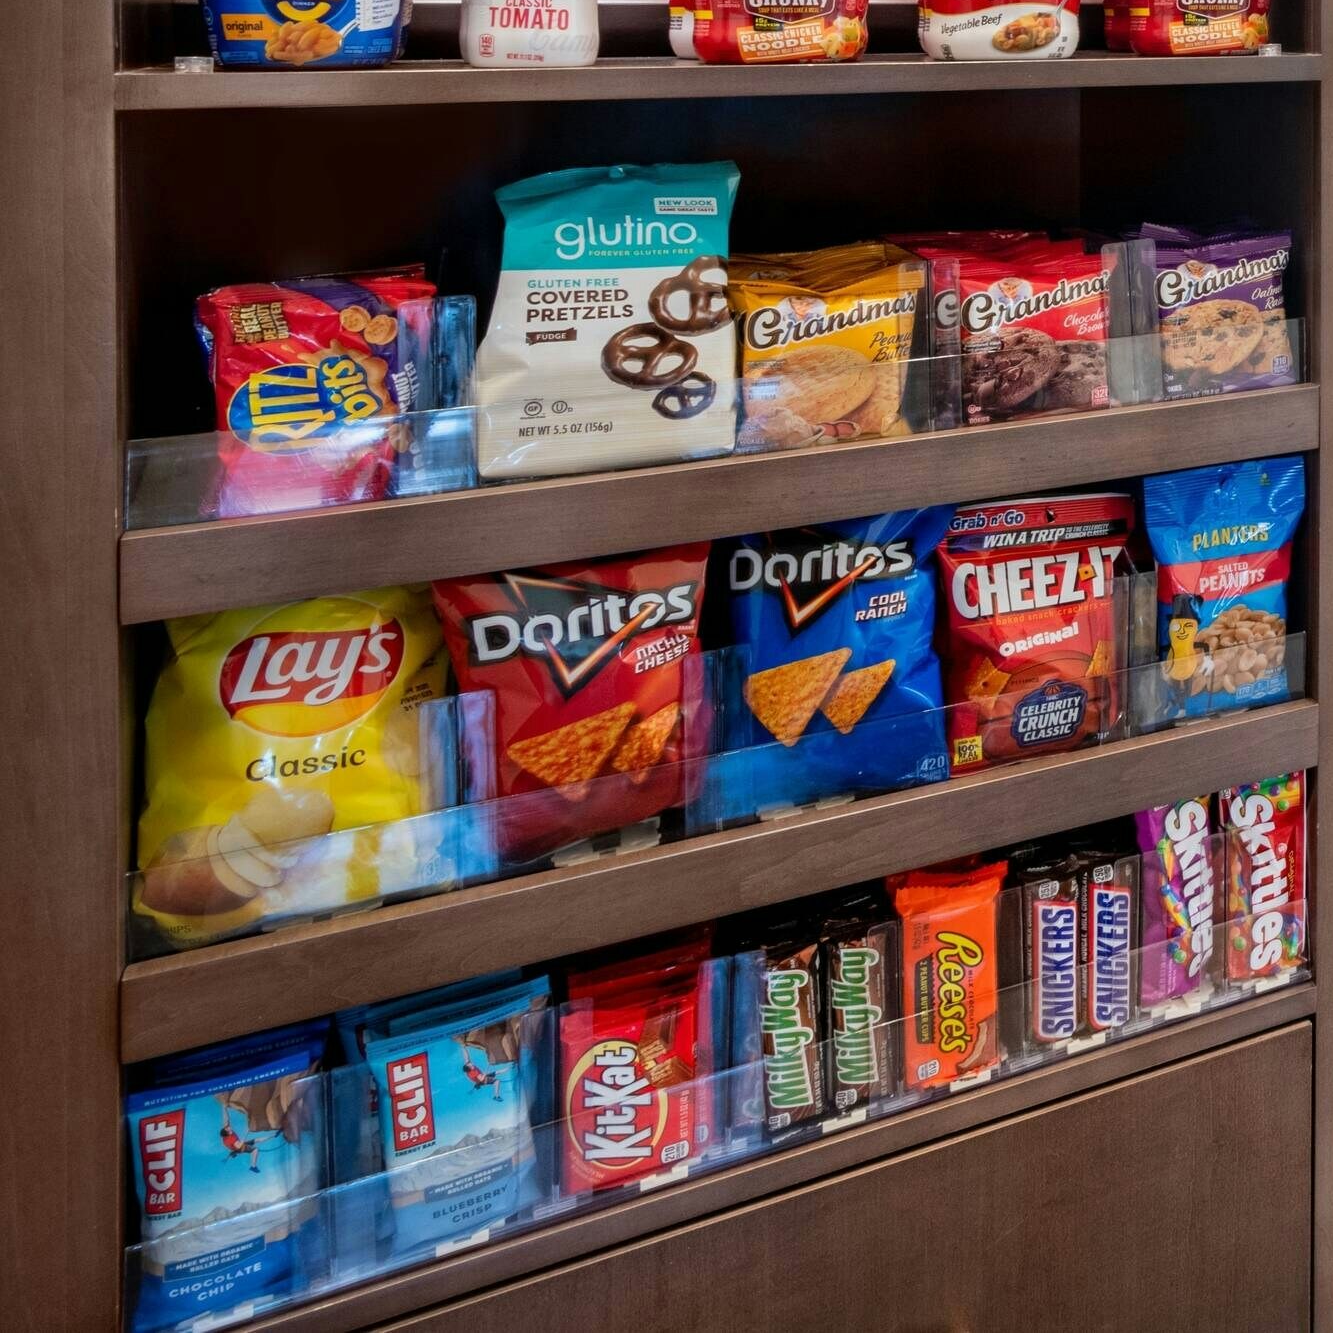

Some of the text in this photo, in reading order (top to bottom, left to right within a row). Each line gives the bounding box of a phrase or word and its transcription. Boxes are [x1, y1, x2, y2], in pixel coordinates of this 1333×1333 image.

[226, 21, 263, 33] original
[489, 7, 569, 30] TOMATO
[941, 14, 1003, 37] Vegetable Beef
[1172, 22, 1240, 37] CLASSIC CHICKEN
[741, 26, 822, 44] CLASSIC CHICKEN
[743, 36, 825, 52] NOODLE
[1173, 30, 1243, 44] NOODLE
[658, 199, 713, 208] NEW LOOK
[554, 215, 697, 261] glutino
[588, 249, 630, 257] FOREVER
[527, 278, 620, 289] GLUTEN FREE
[1154, 250, 1289, 309] Grandma's
[526, 289, 629, 306] COVERED
[525, 304, 634, 323] PRETZELS
[747, 291, 917, 351] Grandma's
[536, 331, 567, 341] FUDGE
[321, 358, 381, 425] bits
[249, 367, 335, 453] RITZ
[519, 421, 613, 438] NET WT 5.5 OZ (156g)
[983, 526, 1065, 549] WIN A TRIP
[1192, 523, 1270, 551] PLANTERS
[730, 541, 913, 591] Doritos
[1217, 562, 1249, 574] SALTED
[1199, 567, 1266, 593] PEANUTS
[868, 590, 906, 608] COOL
[472, 584, 693, 663] Doritos
[854, 602, 907, 622] RANCH
[229, 624, 398, 706] Lay's
[634, 642, 690, 674] CHEESE
[1020, 695, 1081, 716] CELEBRITY
[1018, 708, 1078, 734] CRUNCH
[1023, 723, 1072, 742] CLASSIC
[245, 746, 367, 783] Classic
[920, 755, 945, 772] 420
[1164, 800, 1216, 978] Skittles
[1230, 794, 1290, 972] Skittles
[1096, 893, 1129, 1022] SNICKERS
[1041, 908, 1074, 1035] SNICKERS
[935, 931, 984, 1054] Reese's
[392, 1062, 426, 1128] CLIF
[399, 1124, 429, 1142] BAR
[145, 1118, 177, 1193] CLIF
[149, 1191, 176, 1205] BAR
[432, 1183, 508, 1219] BLUEBERRY
[451, 1203, 493, 1224] CRISP
[169, 1261, 263, 1298] CHOCOLATE
[196, 1283, 235, 1301] CHIP
